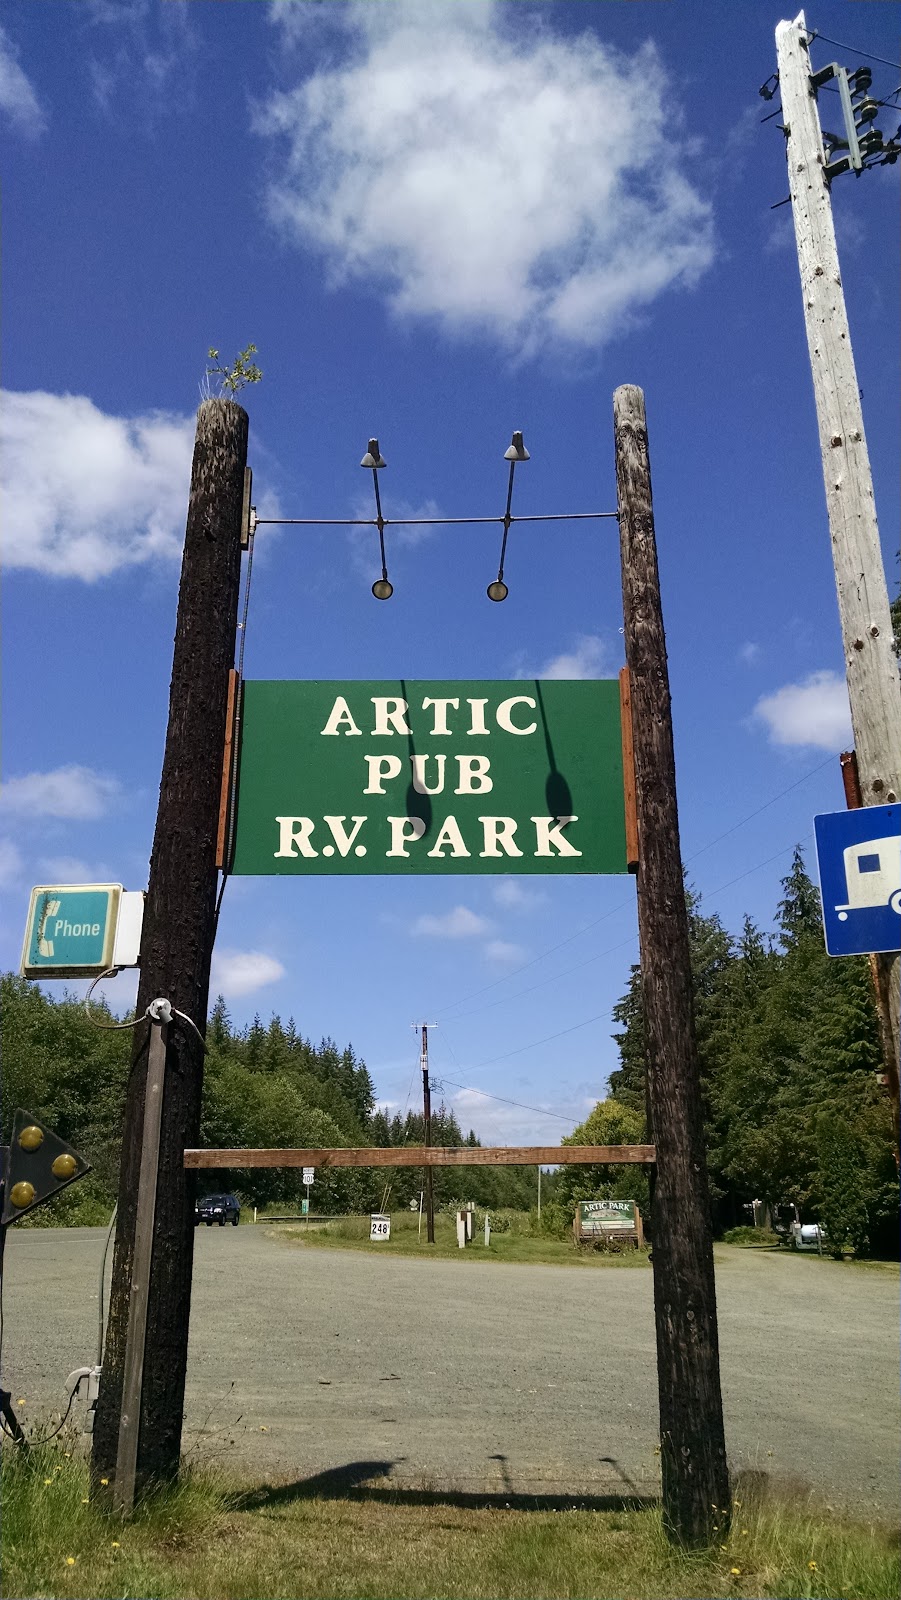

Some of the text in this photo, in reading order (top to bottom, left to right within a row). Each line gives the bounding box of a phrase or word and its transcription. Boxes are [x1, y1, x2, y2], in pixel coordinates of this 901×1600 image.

[320, 696, 537, 736] ARTIC
[363, 754, 494, 795] PUB
[274, 815, 583, 858] R.V. PARK
[54, 920, 100, 937] Phone
[304, 1175, 313, 1183] 101
[584, 1202, 630, 1212] ARTIC PARK
